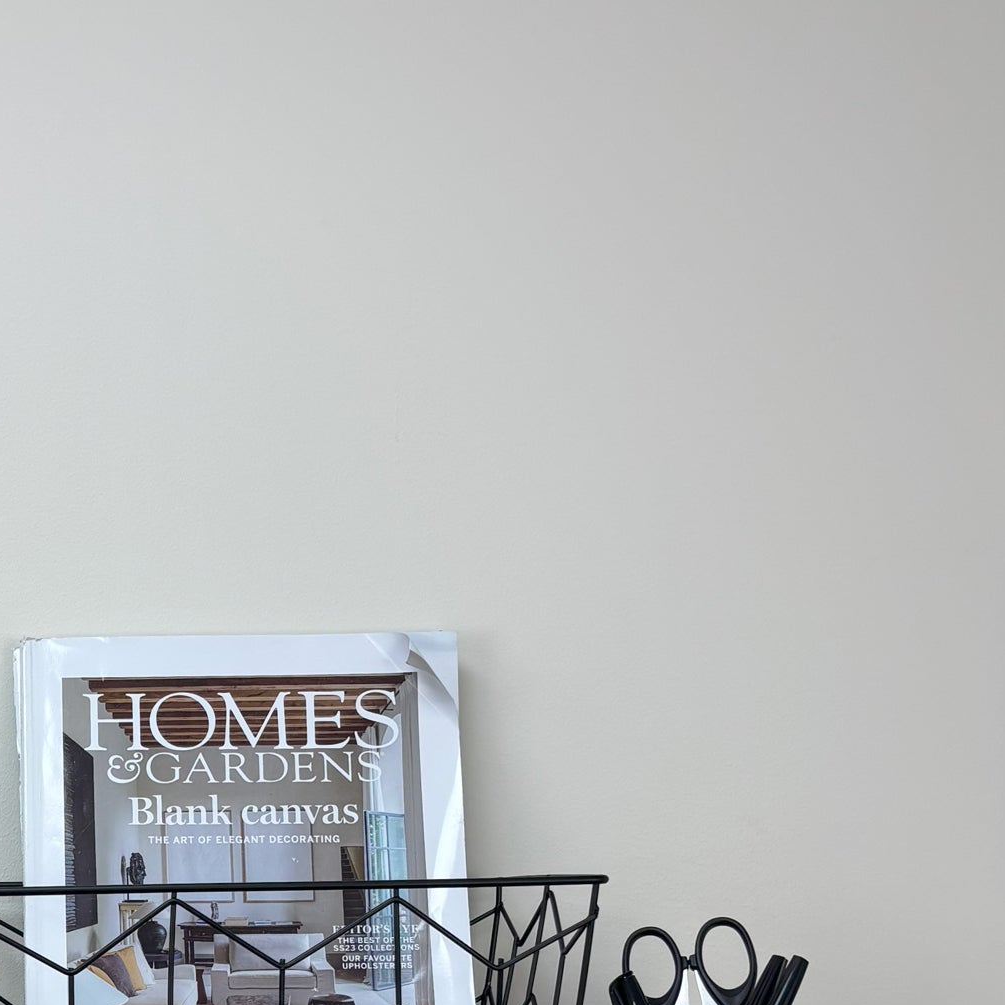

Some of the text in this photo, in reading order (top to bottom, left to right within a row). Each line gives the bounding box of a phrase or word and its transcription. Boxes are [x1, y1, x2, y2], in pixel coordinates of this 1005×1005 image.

[83, 690, 400, 751] HOMES
[128, 795, 360, 826] Blank canvas
[148, 834, 340, 844] THE ART OF ELEGANT DECORATING
[332, 924, 390, 934] EITOR'S
[399, 936, 415, 944] HE
[357, 944, 420, 952] COLLECONS
[363, 954, 412, 962] FAVOUTE
[342, 962, 413, 970] UPHOLSTERRS
